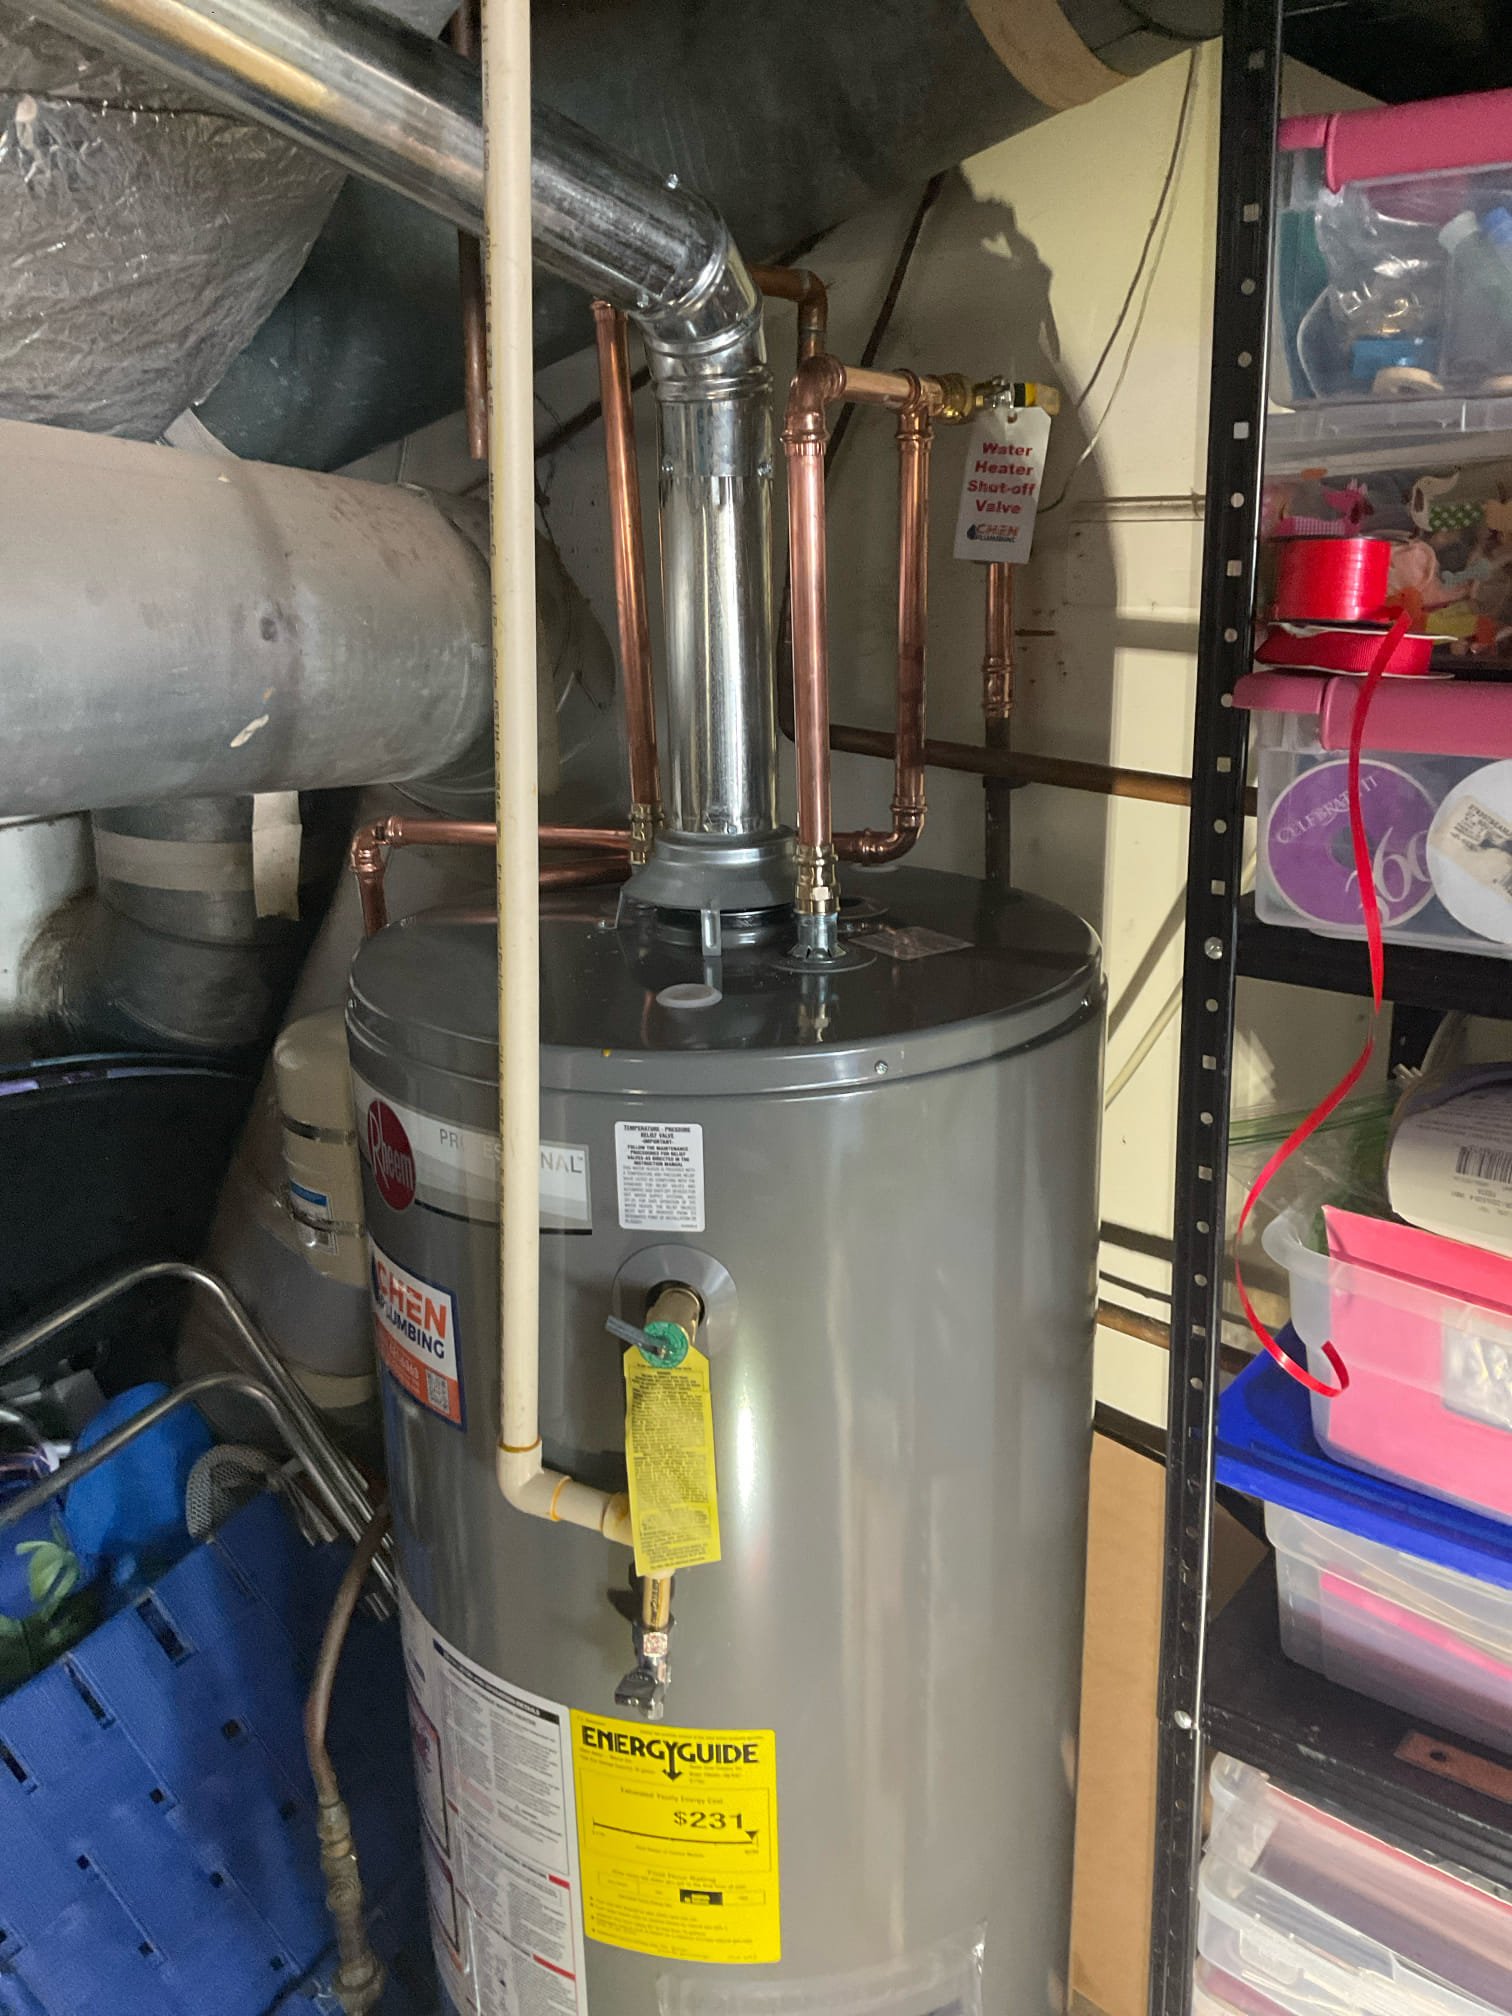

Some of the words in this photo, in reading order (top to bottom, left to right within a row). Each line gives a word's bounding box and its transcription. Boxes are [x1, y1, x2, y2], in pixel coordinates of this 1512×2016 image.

[982, 442, 1033, 457] Water
[975, 460, 1034, 476] Heater
[967, 480, 1036, 496] Shut-off
[976, 500, 1023, 514] Valve
[976, 523, 1020, 537] CHEN
[369, 1099, 415, 1191] Rheem
[377, 1260, 447, 1339] CHEN
[376, 1294, 445, 1359] PLUMBING
[582, 1725, 759, 1768] ENERGYGUIDE
[673, 1811, 743, 1829] $231
